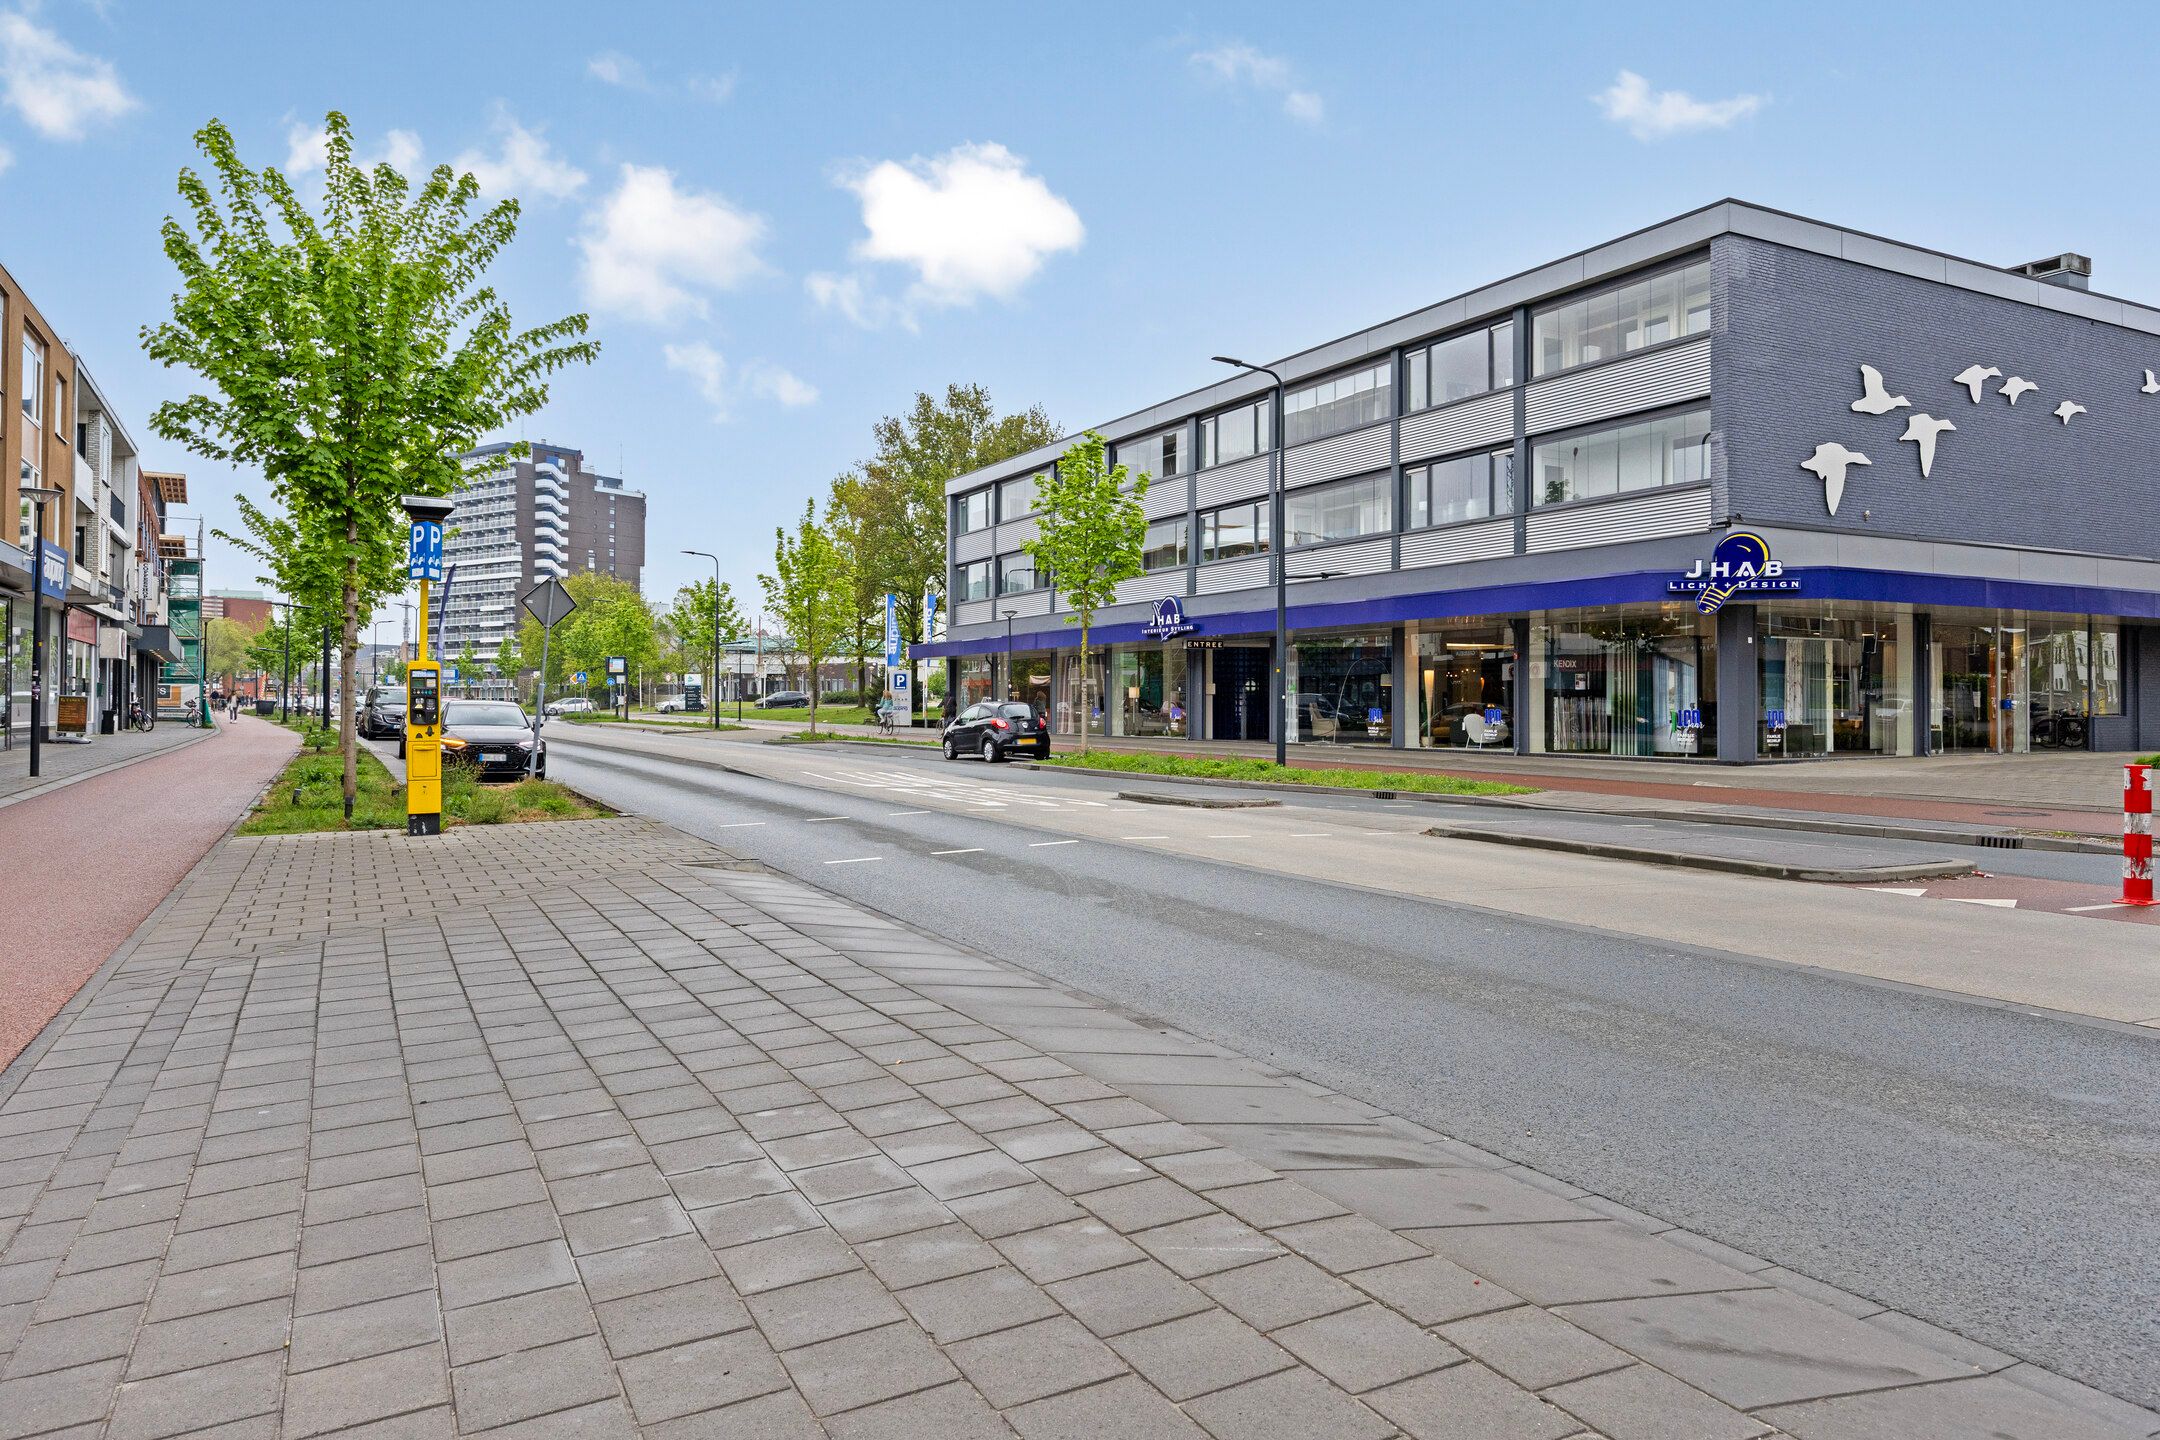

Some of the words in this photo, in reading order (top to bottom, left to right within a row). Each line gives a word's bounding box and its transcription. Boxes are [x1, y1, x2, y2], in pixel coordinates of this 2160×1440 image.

[413, 525, 424, 553] P
[431, 525, 441, 553] P
[1686, 559, 1783, 578] JHAB
[1149, 613, 1180, 626] JHAB
[1141, 626, 1169, 634] INTERIEUR
[1553, 660, 1577, 668] KENDIX
[896, 675, 905, 686] P
[1677, 709, 1701, 726] 100
